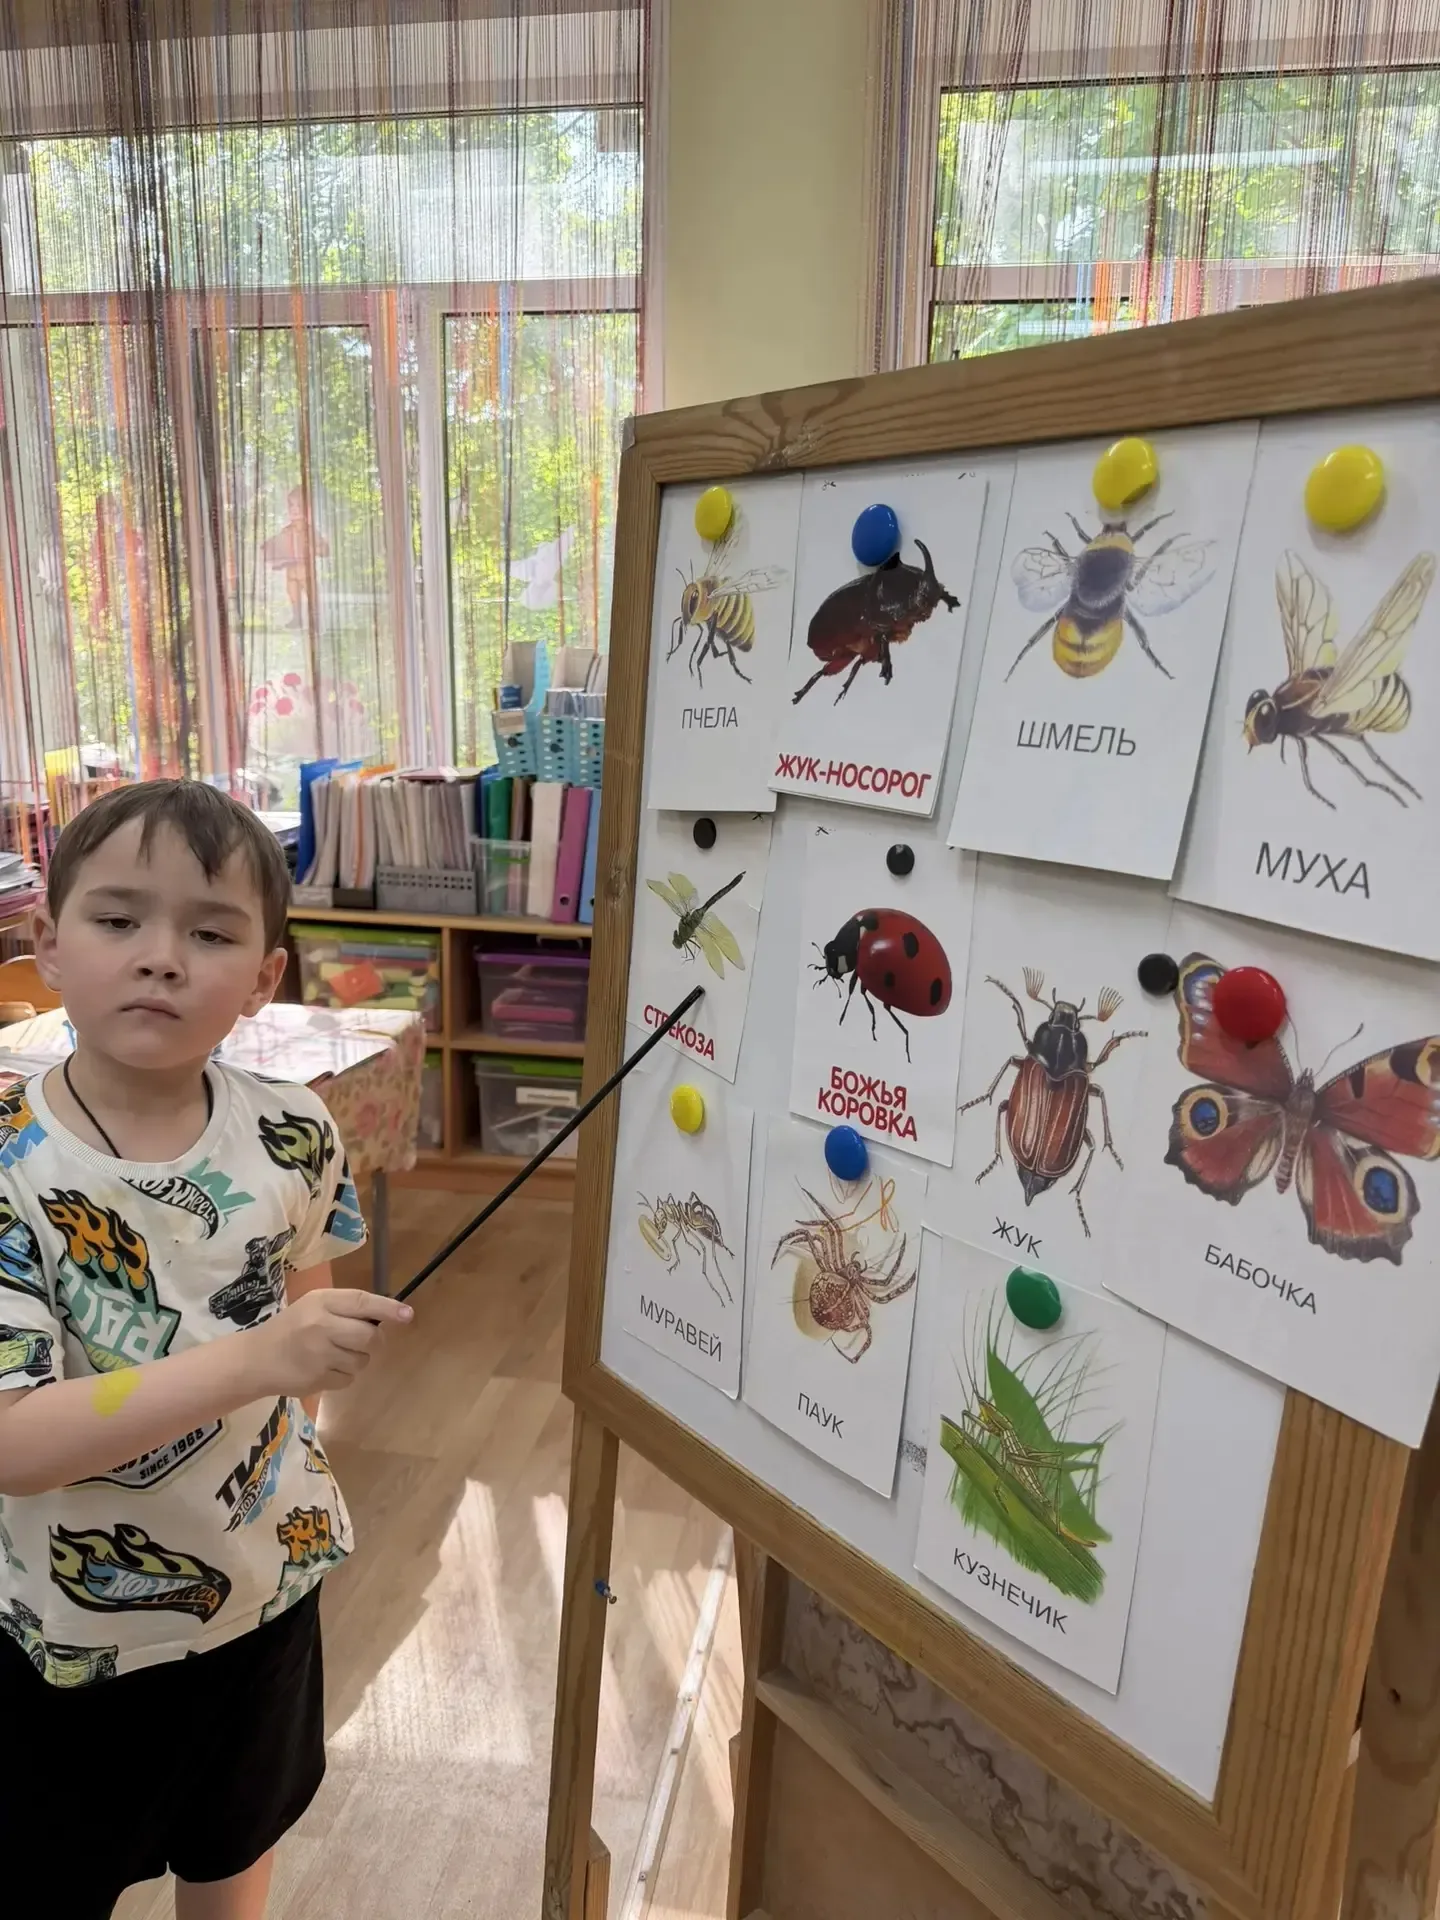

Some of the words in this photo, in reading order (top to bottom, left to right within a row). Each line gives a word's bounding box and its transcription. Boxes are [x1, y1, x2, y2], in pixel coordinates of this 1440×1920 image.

[681, 706, 739, 729] ПЧЕЛА
[1016, 719, 1137, 757] ШМЕЛЬ
[774, 752, 932, 799] ЖУК-НОСОРОГ
[1255, 841, 1370, 900] МУХА
[830, 1065, 907, 1111] БОЖЬЯ
[818, 1087, 918, 1142] КОРОВКА
[991, 1216, 1043, 1260] ЖУК
[1204, 1243, 1317, 1315] БАБОЧКА
[640, 1294, 722, 1363] МУРАВЕЙ
[797, 1392, 845, 1439] ПАУК
[139, 1453, 170, 1481] SINCE
[170, 1427, 205, 1458] 1968
[953, 1547, 1068, 1635] КУЗНЕЧИК
